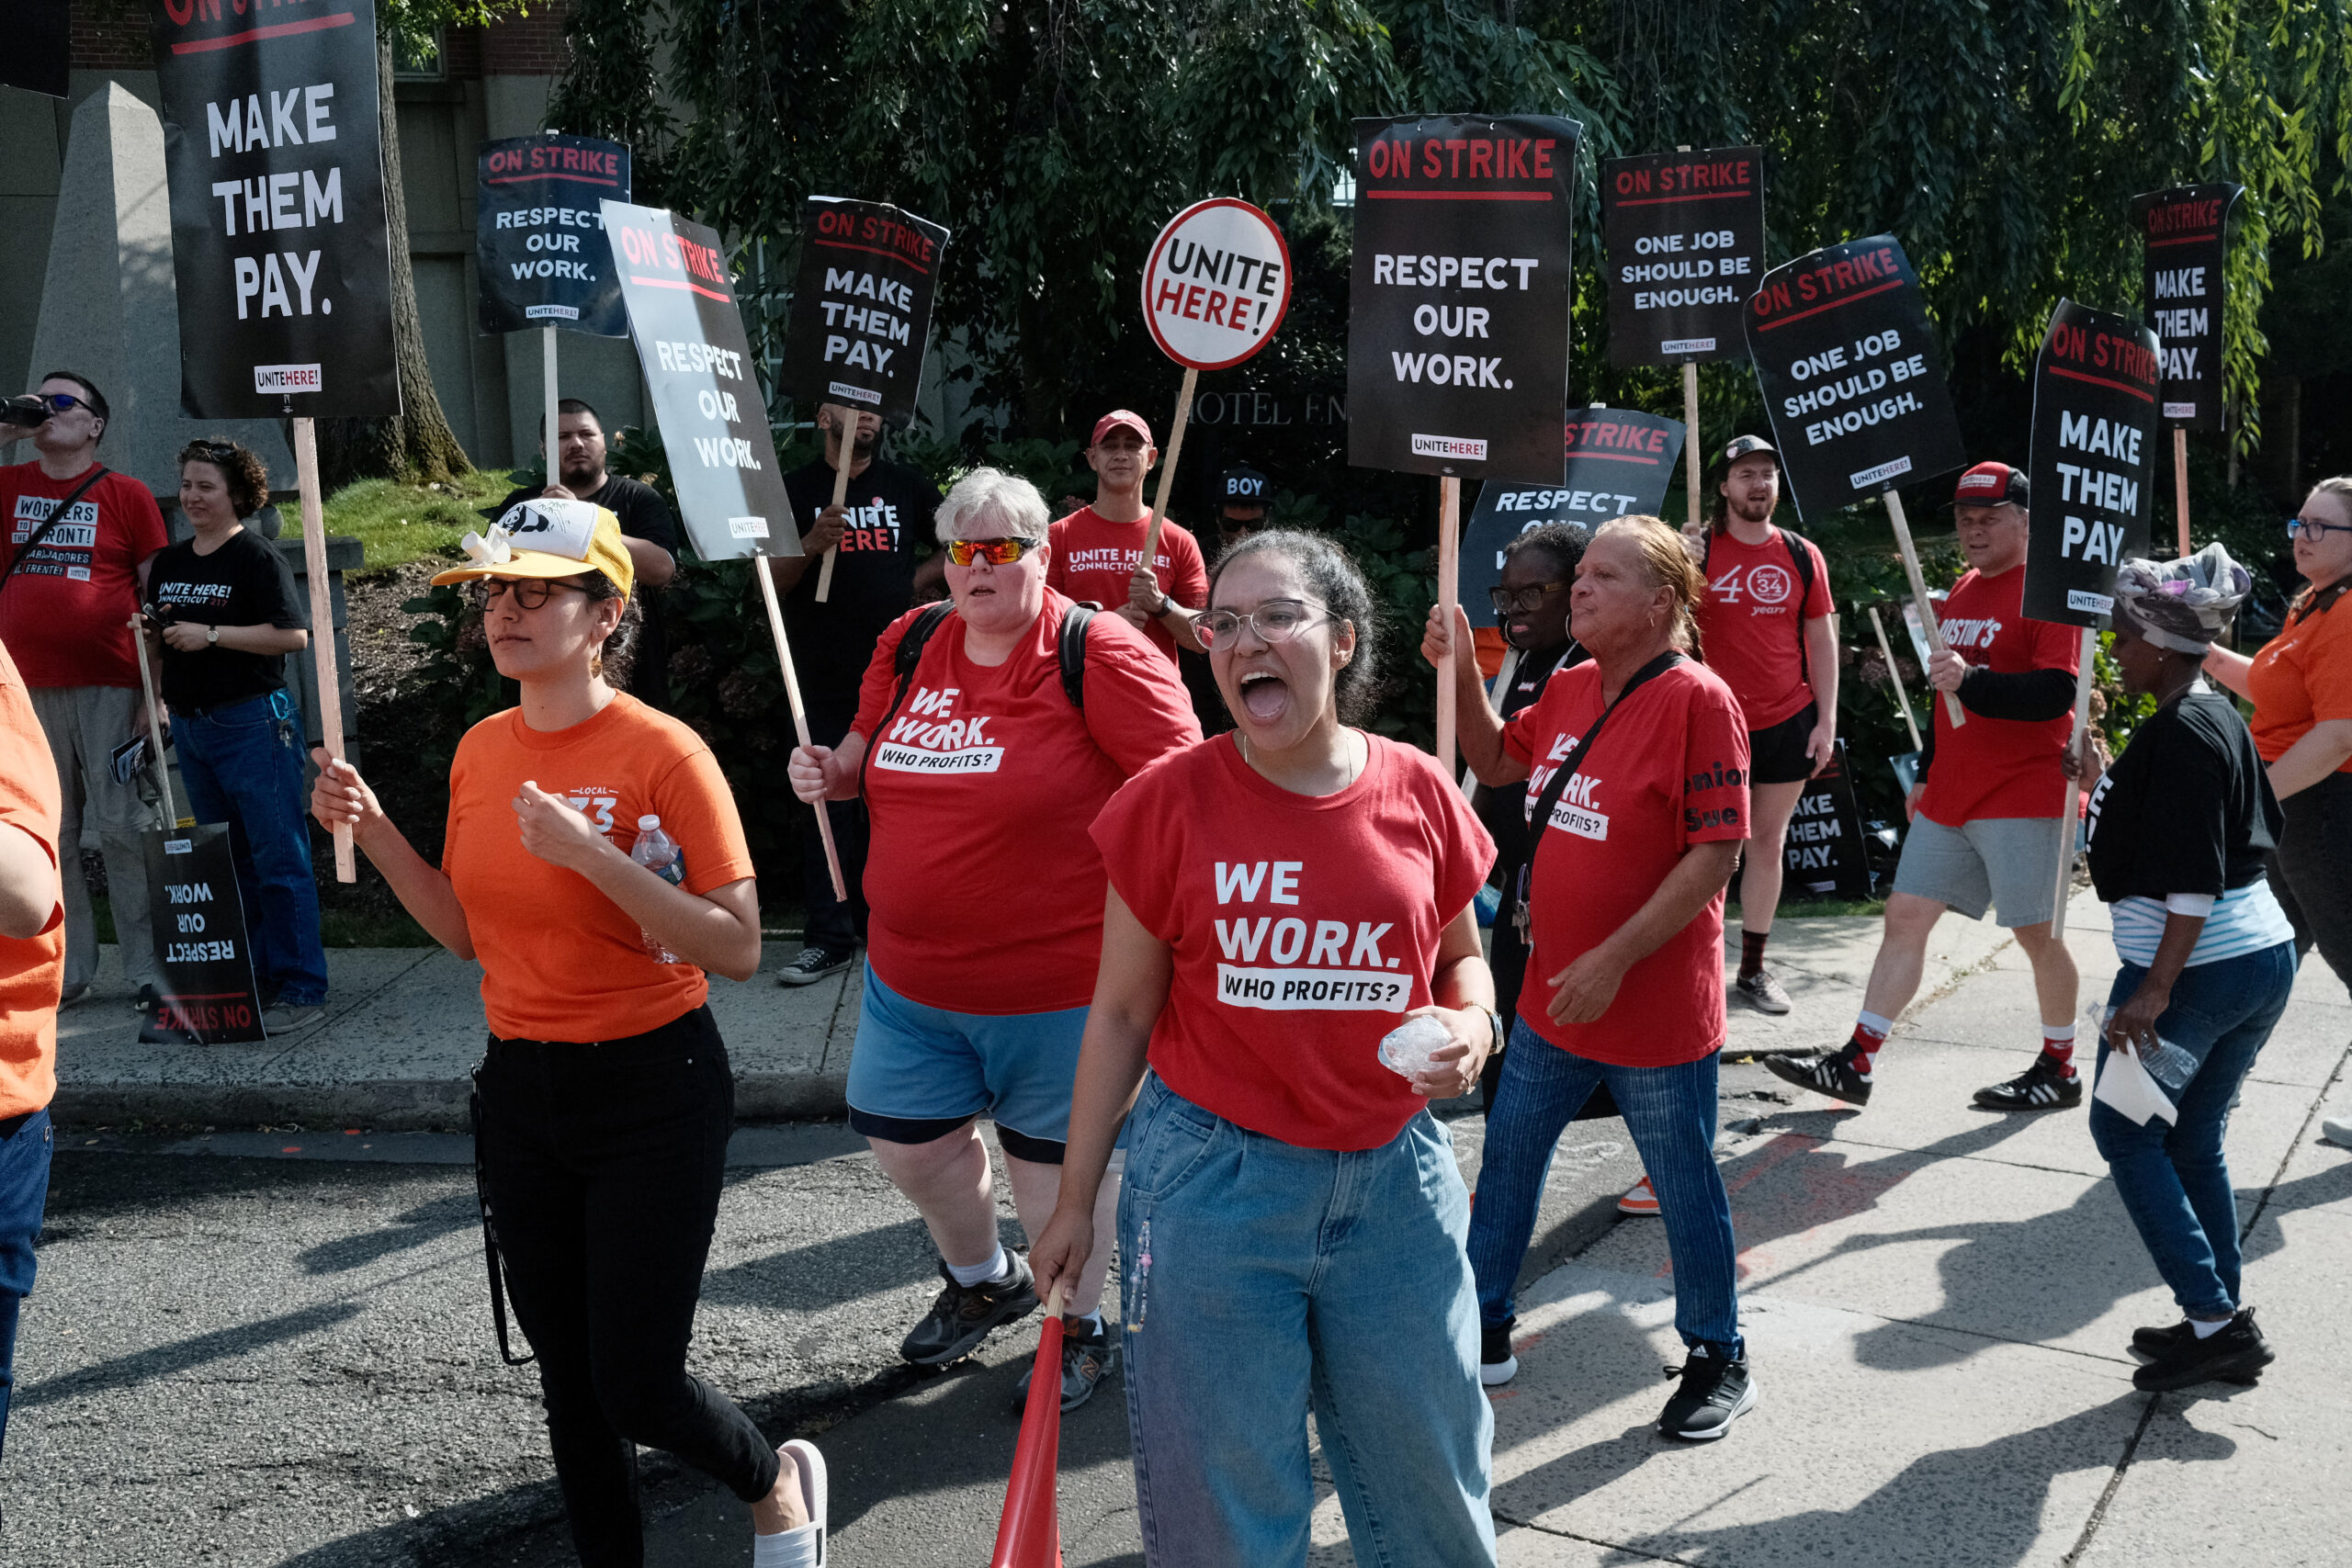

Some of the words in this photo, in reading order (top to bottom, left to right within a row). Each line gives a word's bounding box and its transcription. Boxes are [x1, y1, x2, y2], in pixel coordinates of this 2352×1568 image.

[207, 83, 336, 157] MAKE
[489, 152, 521, 174] ON
[531, 147, 617, 176] STRIKE
[1369, 140, 1410, 178] ON
[1424, 139, 1555, 178] STRIKE
[1616, 170, 1650, 195] ON
[1659, 162, 1750, 190] STRIKE
[212, 167, 343, 236] THEM
[2148, 208, 2165, 232] ON
[2166, 199, 2222, 231] STRIKE
[526, 233, 580, 253] OUR
[818, 210, 854, 235] ON
[862, 217, 933, 262] STRIKE
[1634, 234, 1683, 254] ONE
[1690, 231, 1735, 250] JOB
[621, 226, 661, 269] ON
[662, 234, 724, 284] STRIKE
[1167, 239, 1281, 298] UNITE
[1622, 260, 1714, 283] SHOULD
[1720, 256, 1750, 275] BE
[234, 250, 331, 320] PAY.
[511, 260, 596, 282] WORK.
[1374, 254, 1538, 290] RESPECT
[1753, 282, 1792, 316] ON
[1797, 247, 1898, 300] STRIKE
[2154, 266, 2205, 299] MAKE
[825, 267, 913, 310] MAKE
[1634, 287, 1739, 310] ENOUGH.
[1155, 278, 1267, 335] HERE!
[1414, 305, 1489, 338] OUR
[820, 301, 910, 347] THEM
[2154, 308, 2209, 339] THEM
[656, 341, 742, 381] RESPECT
[824, 335, 893, 378] PAY.
[1791, 347, 1847, 380] ONE
[1854, 330, 1901, 360] JOB
[2052, 323, 2085, 362] ON
[2094, 333, 2157, 386] STRIKE
[2159, 347, 2202, 380] PAY.
[1392, 352, 1513, 389] WORK.
[1784, 369, 1886, 418] SHOULD
[1892, 355, 1927, 382] BE
[699, 390, 740, 423] OUR
[1806, 392, 1923, 446] ENOUGH.
[1415, 439, 1484, 456] UNITEHERE!
[1565, 423, 1668, 453] STRIKE
[2059, 411, 2142, 466] MAKE
[695, 437, 762, 471] WORK.
[1227, 478, 1263, 496] BOY
[2056, 463, 2138, 516] THEM
[20, 500, 94, 522] WORERS
[815, 505, 900, 529] NITE
[1495, 491, 1637, 515] RESPECT
[13, 534, 27, 542] THE
[45, 527, 91, 544] RONT!
[841, 528, 899, 553] ERE!
[2061, 516, 2124, 568] PAY.
[26, 549, 89, 563] ABAJADORES
[1069, 548, 1119, 563] UNITE
[1070, 561, 1134, 572] CONNECTIC
[193, 583, 232, 599] HERE!
[1757, 579, 1782, 592] 34
[209, 598, 228, 607] 217
[1751, 606, 1786, 616] years
[909, 686, 960, 718] WE
[888, 716, 995, 750] WORK.
[882, 750, 917, 766] WHO
[919, 753, 993, 768] PROFITS?
[1685, 806, 1738, 832] Sue
[1792, 794, 1835, 818] AKE
[1786, 818, 1842, 843] HEM
[1788, 845, 1838, 870] PAY.
[165, 883, 213, 904] WORK.
[1215, 862, 1303, 905] WE
[177, 913, 206, 932] OUR
[166, 940, 235, 963] RESPECT
[1215, 918, 1401, 968] WORK.
[1225, 974, 1275, 1001] WHO
[1283, 980, 1399, 1003] PROFITS?
[153, 1006, 220, 1030] STRIKE
[224, 1004, 252, 1028] ON
